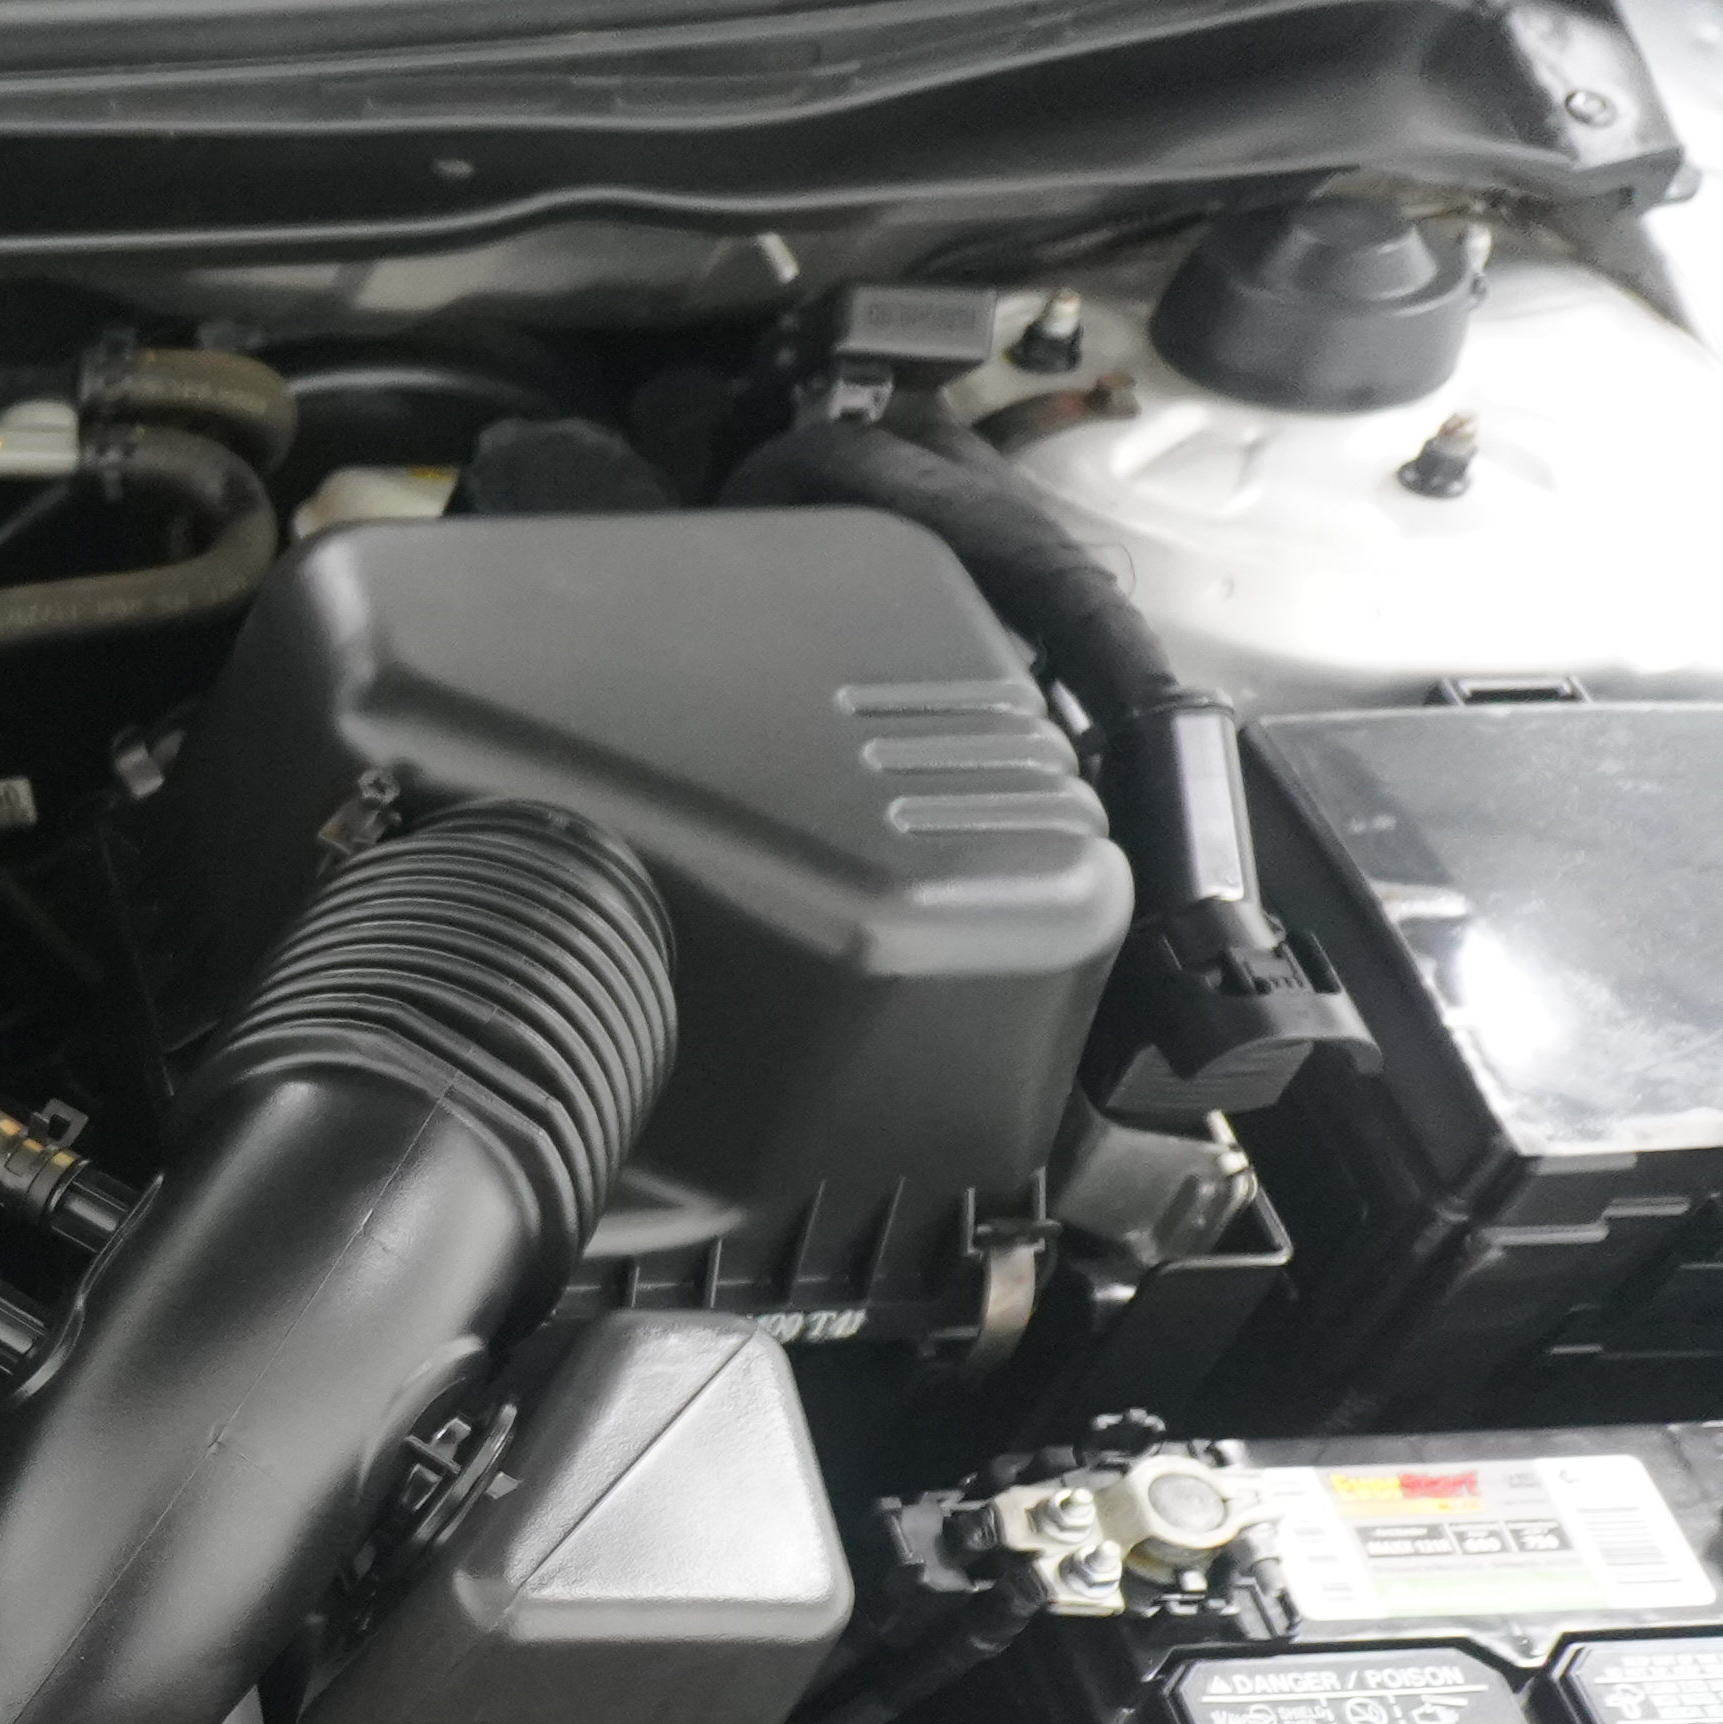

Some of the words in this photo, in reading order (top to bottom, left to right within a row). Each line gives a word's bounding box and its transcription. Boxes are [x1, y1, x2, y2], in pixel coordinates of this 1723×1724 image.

[1231, 1671, 1341, 1695] DANGER
[1366, 1666, 1466, 1689] POISON
[1278, 1706, 1326, 1720] SHIELD
